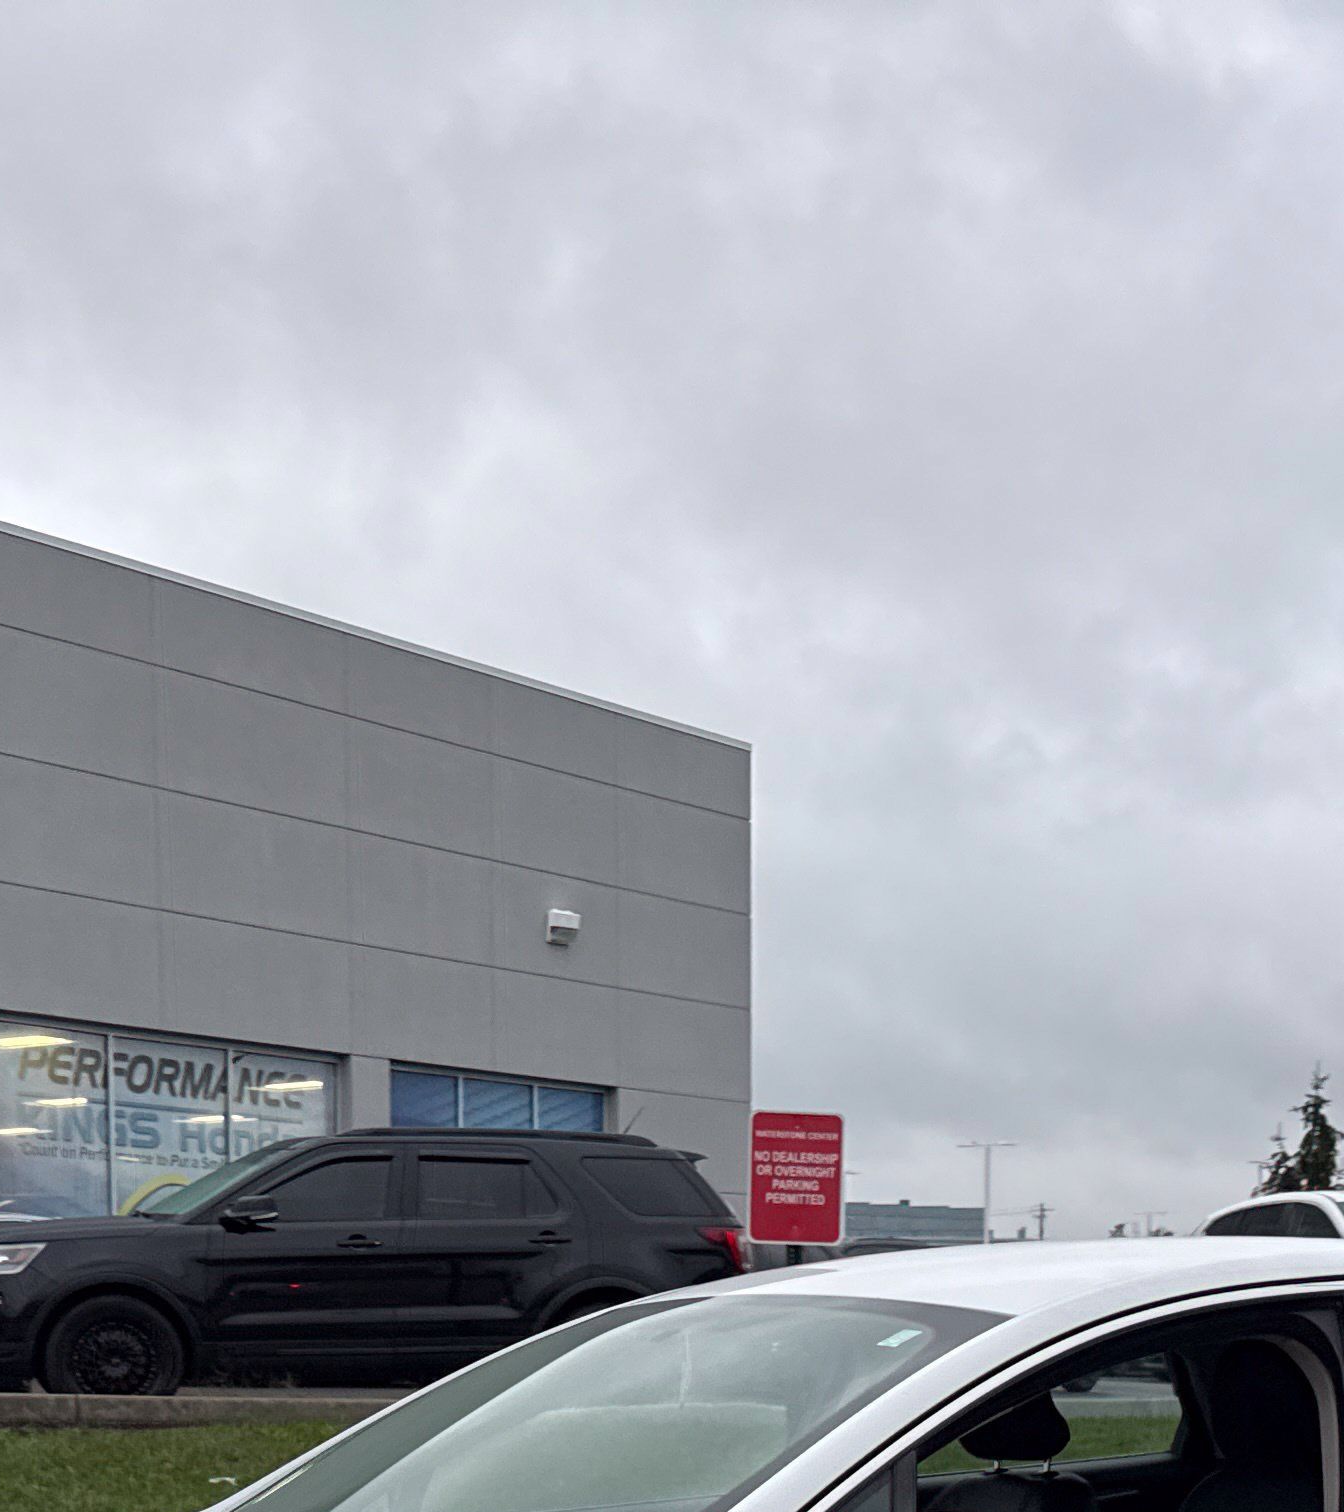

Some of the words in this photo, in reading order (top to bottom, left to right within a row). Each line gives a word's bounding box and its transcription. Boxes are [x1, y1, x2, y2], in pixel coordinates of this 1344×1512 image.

[17, 1044, 307, 1110] PERFORMANCE
[807, 1132, 838, 1141] CENTER
[754, 1151, 770, 1162] NO
[772, 1151, 838, 1164] DEALERSHIP
[756, 1164, 772, 1176] OR
[774, 1165, 836, 1178] OVERNIGHT
[772, 1179, 819, 1191] PARKING
[764, 1192, 825, 1205] PERMITTED
